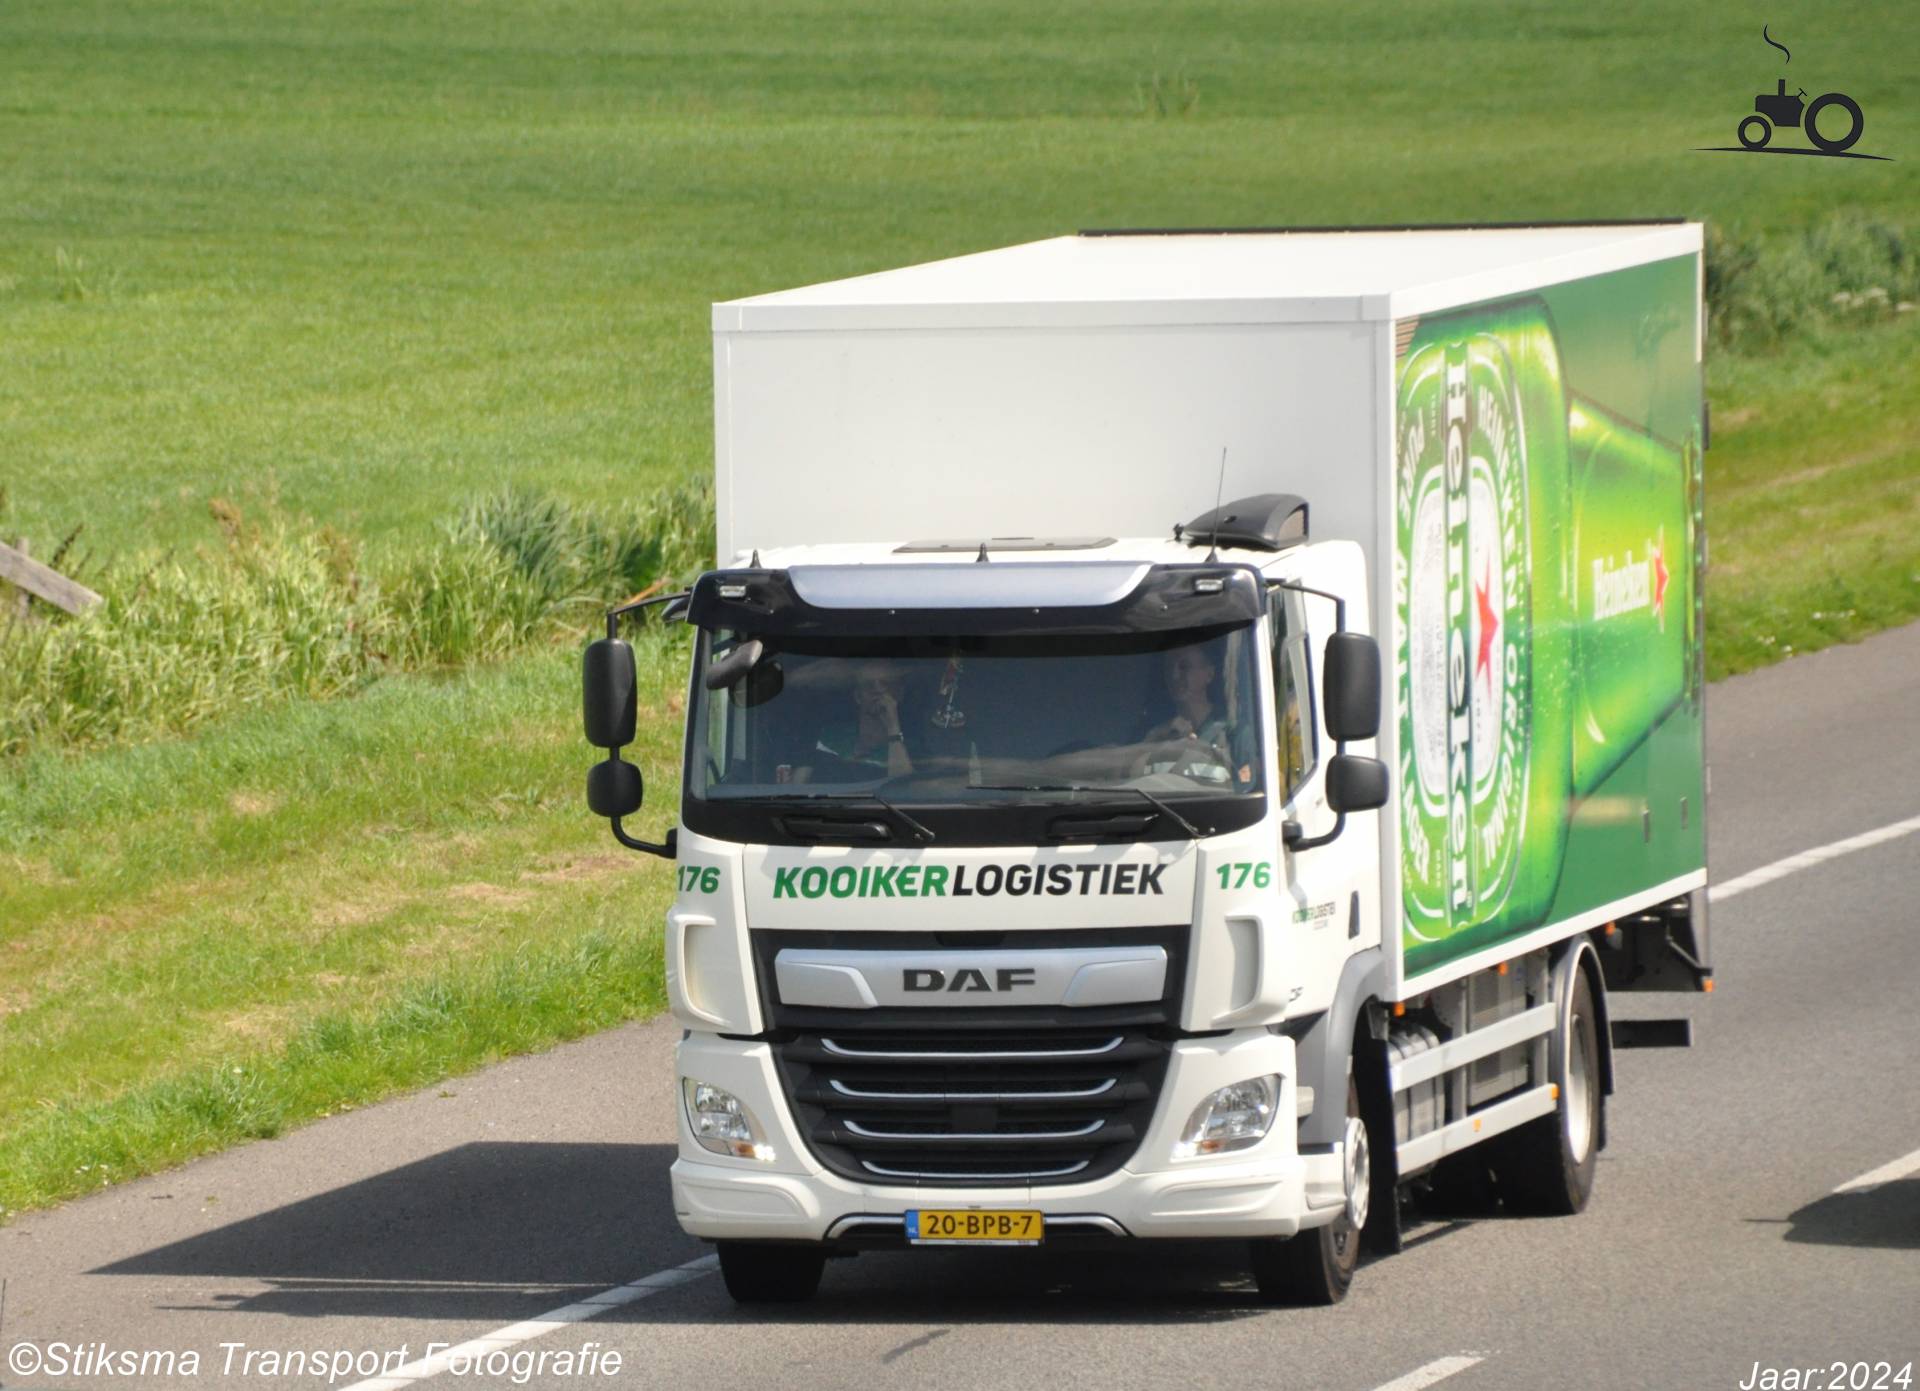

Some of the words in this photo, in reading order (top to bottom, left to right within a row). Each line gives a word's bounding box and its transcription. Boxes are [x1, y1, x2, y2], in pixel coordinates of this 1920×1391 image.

[1478, 385, 1517, 609] HEINEKEN
[1446, 361, 1470, 910] Heineken
[1482, 643, 1518, 867] ORIGINAL
[678, 865, 721, 895] 176
[1216, 862, 1271, 890] 176
[902, 968, 1036, 993] DAF
[927, 1215, 1033, 1236] 20-BPB-7
